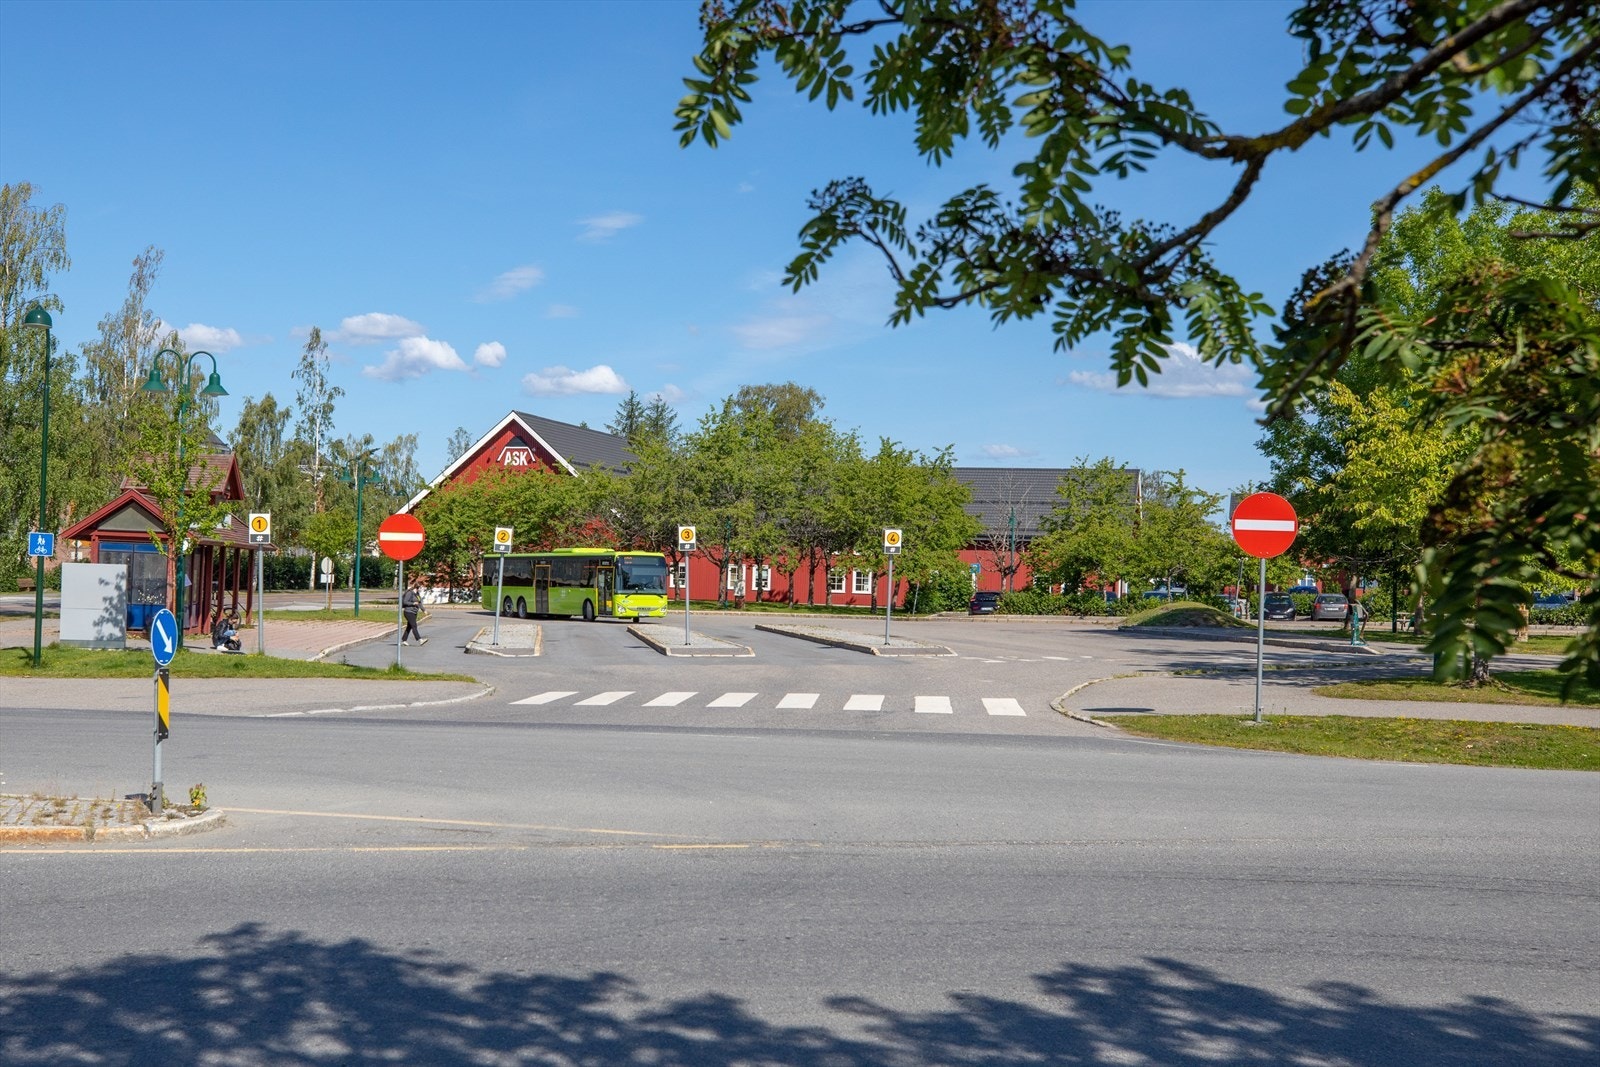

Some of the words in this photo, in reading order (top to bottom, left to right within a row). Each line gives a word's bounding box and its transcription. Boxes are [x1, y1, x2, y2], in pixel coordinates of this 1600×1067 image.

[504, 451, 528, 466] ASK
[500, 532, 506, 540] 2
[684, 531, 690, 539] 3
[890, 534, 896, 542] 4
